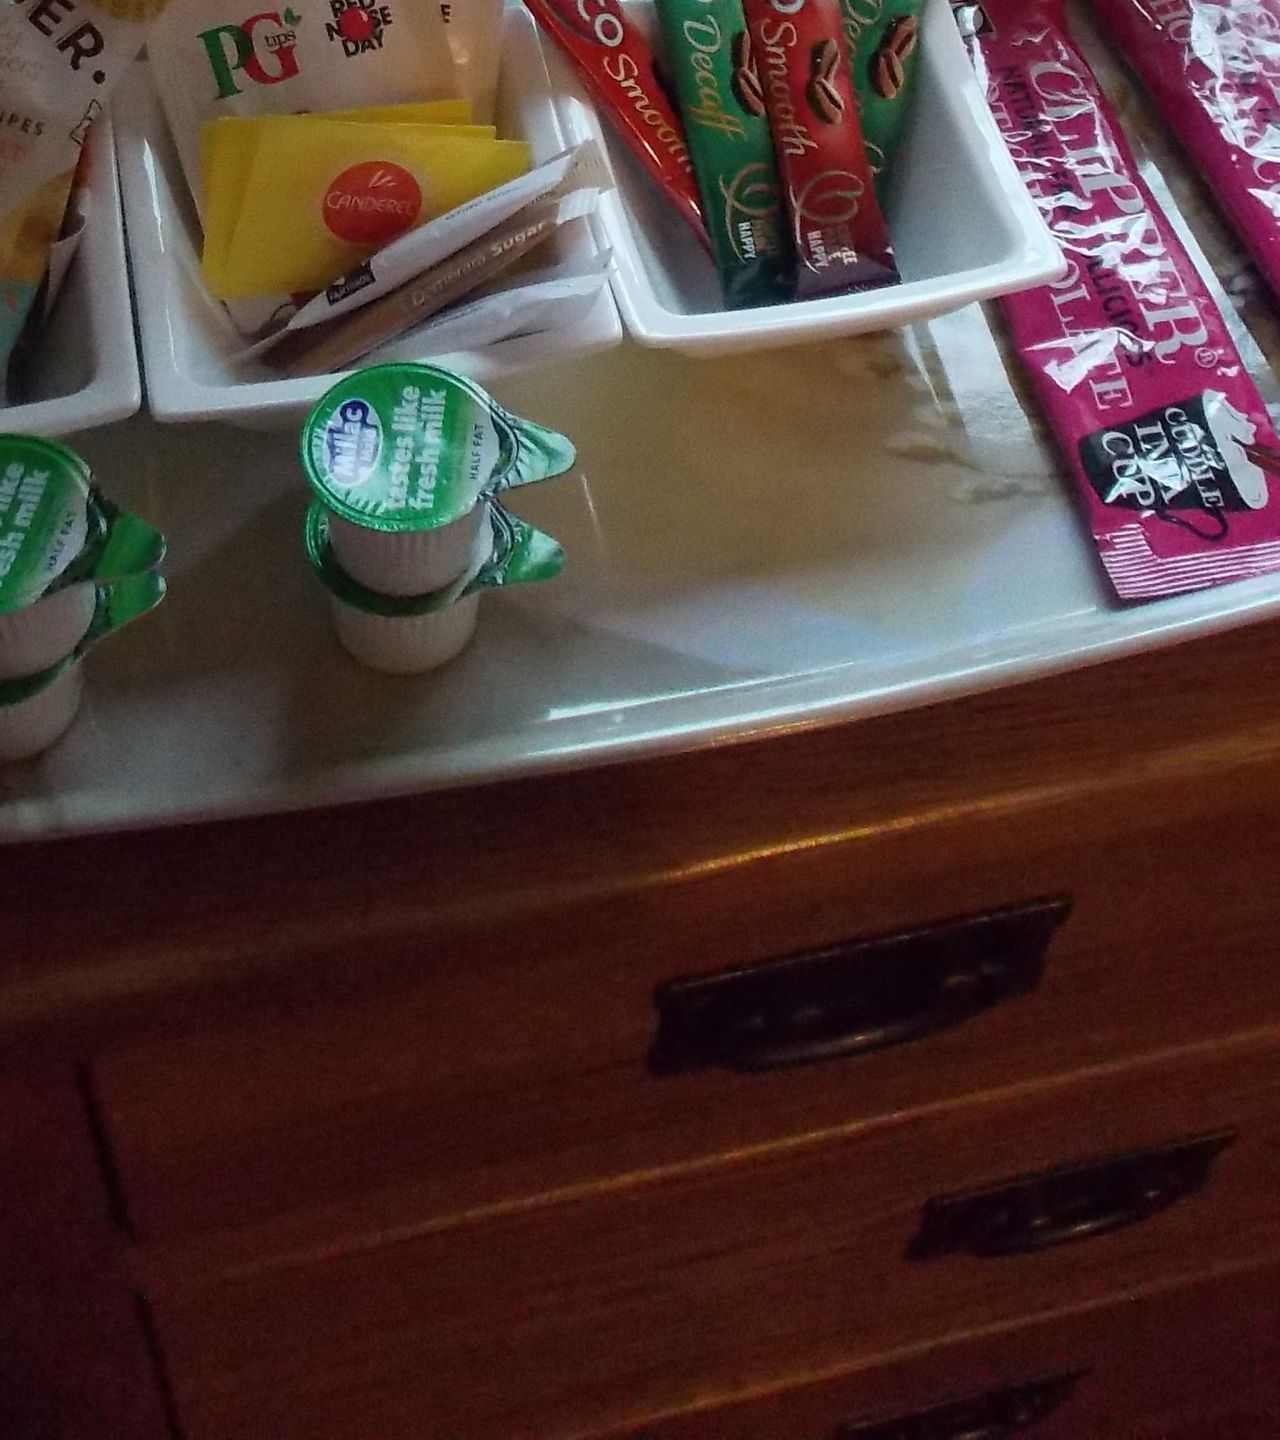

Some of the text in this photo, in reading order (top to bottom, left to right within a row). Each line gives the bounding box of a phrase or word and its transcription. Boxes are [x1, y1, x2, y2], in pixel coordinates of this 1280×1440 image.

[196, 10, 301, 100] PG
[263, 29, 298, 47] tips
[341, 27, 385, 58] DAY
[682, 13, 748, 143] Decaff
[760, 19, 819, 157] Smooth
[325, 190, 415, 216] CANDEREL
[490, 219, 545, 258] Sugar
[736, 220, 757, 260] HAPPY
[332, 406, 369, 477] Millac
[386, 385, 420, 509] tastes like
[407, 388, 447, 510] fresh milk
[469, 424, 485, 480] HALF FAT
[1101, 430, 1155, 507] CUP
[1164, 407, 1226, 509] CUDDLE
[14, 468, 52, 528] milk
